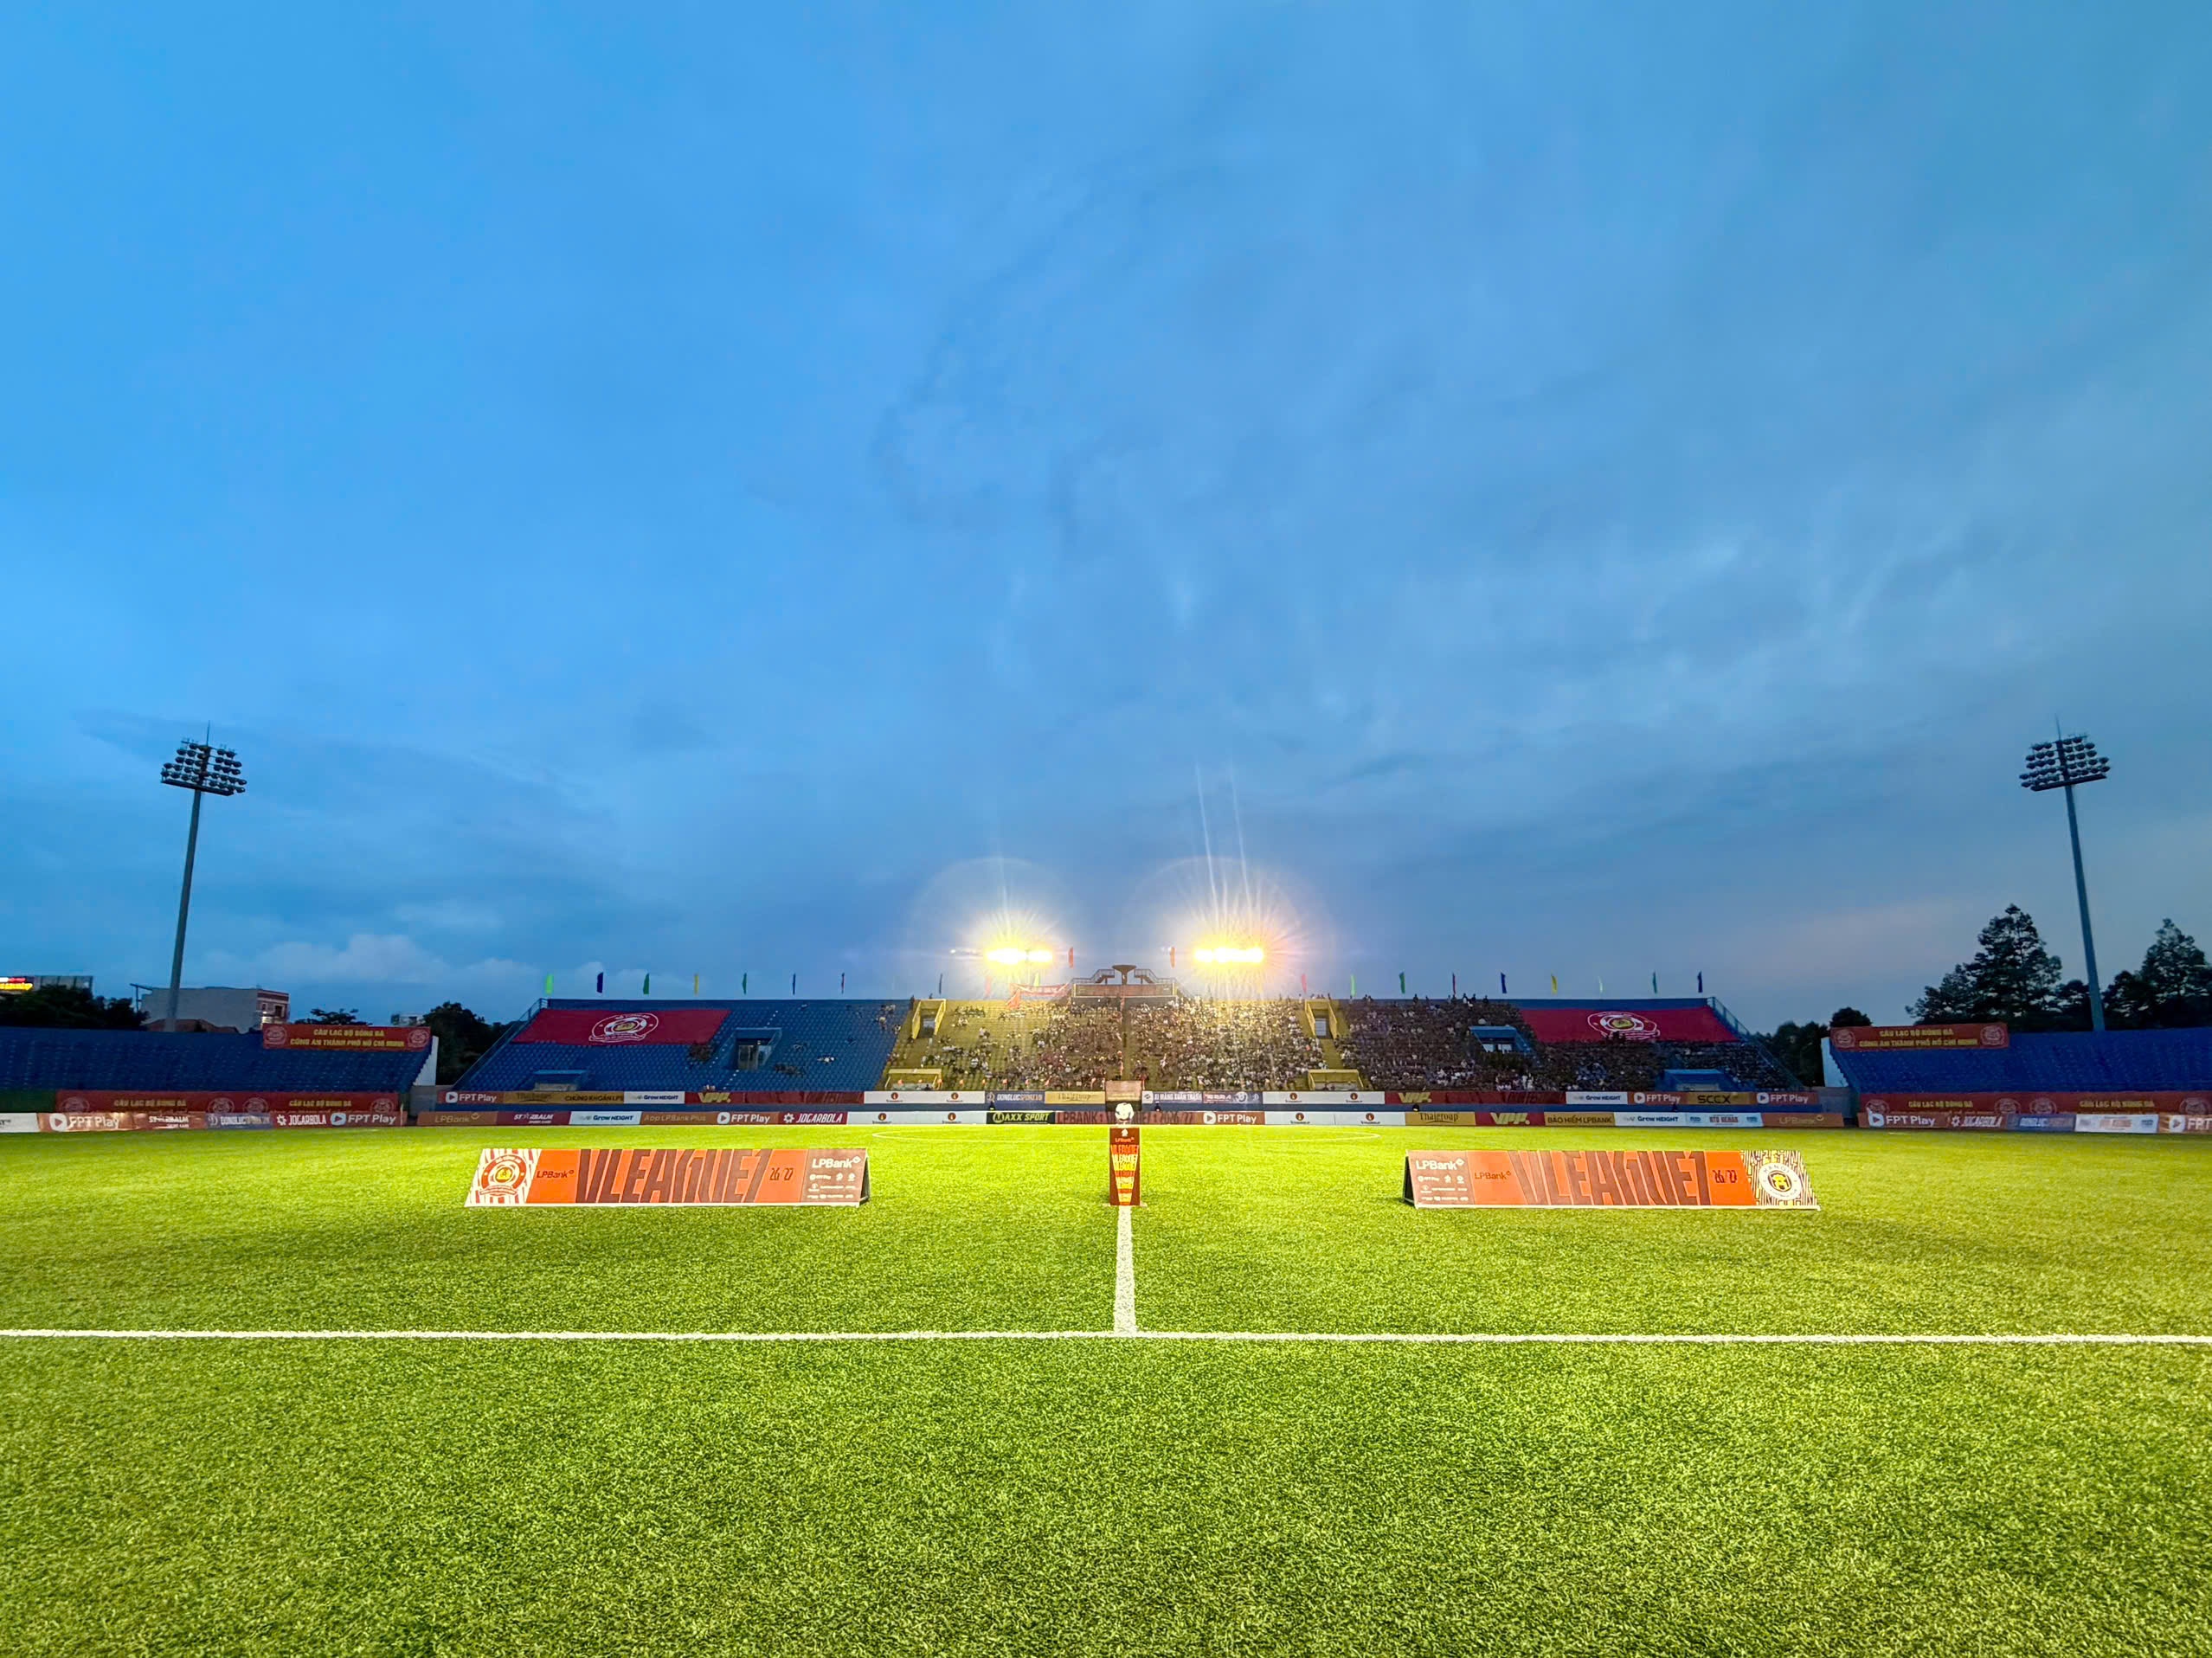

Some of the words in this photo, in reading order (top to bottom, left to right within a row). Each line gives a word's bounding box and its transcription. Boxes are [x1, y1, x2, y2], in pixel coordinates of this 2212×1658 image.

[459, 1093, 477, 1102] FPT
[478, 1093, 497, 1103] Play
[1647, 1094, 1662, 1102] FPT
[1663, 1094, 1682, 1104] Play
[1697, 1095, 1731, 1104] SCCX
[1790, 1094, 1809, 1104] Play
[69, 1115, 93, 1128] FPT
[94, 1115, 119, 1129] Play
[348, 1115, 370, 1123] FPT
[372, 1114, 396, 1125] Play
[434, 1114, 470, 1122] LPBank
[731, 1114, 749, 1122] FPT
[750, 1114, 770, 1124] Play
[795, 1113, 842, 1123] JOGARBOLA
[1025, 1113, 1050, 1121] SPORT
[1218, 1114, 1236, 1123] FPT
[1237, 1114, 1257, 1124] Play
[1887, 1115, 1909, 1124] FPT
[1910, 1115, 1935, 1127] Play
[812, 1158, 852, 1168] LPBank
[1416, 1160, 1457, 1170] LPBank
[537, 1170, 568, 1179] LPBank
